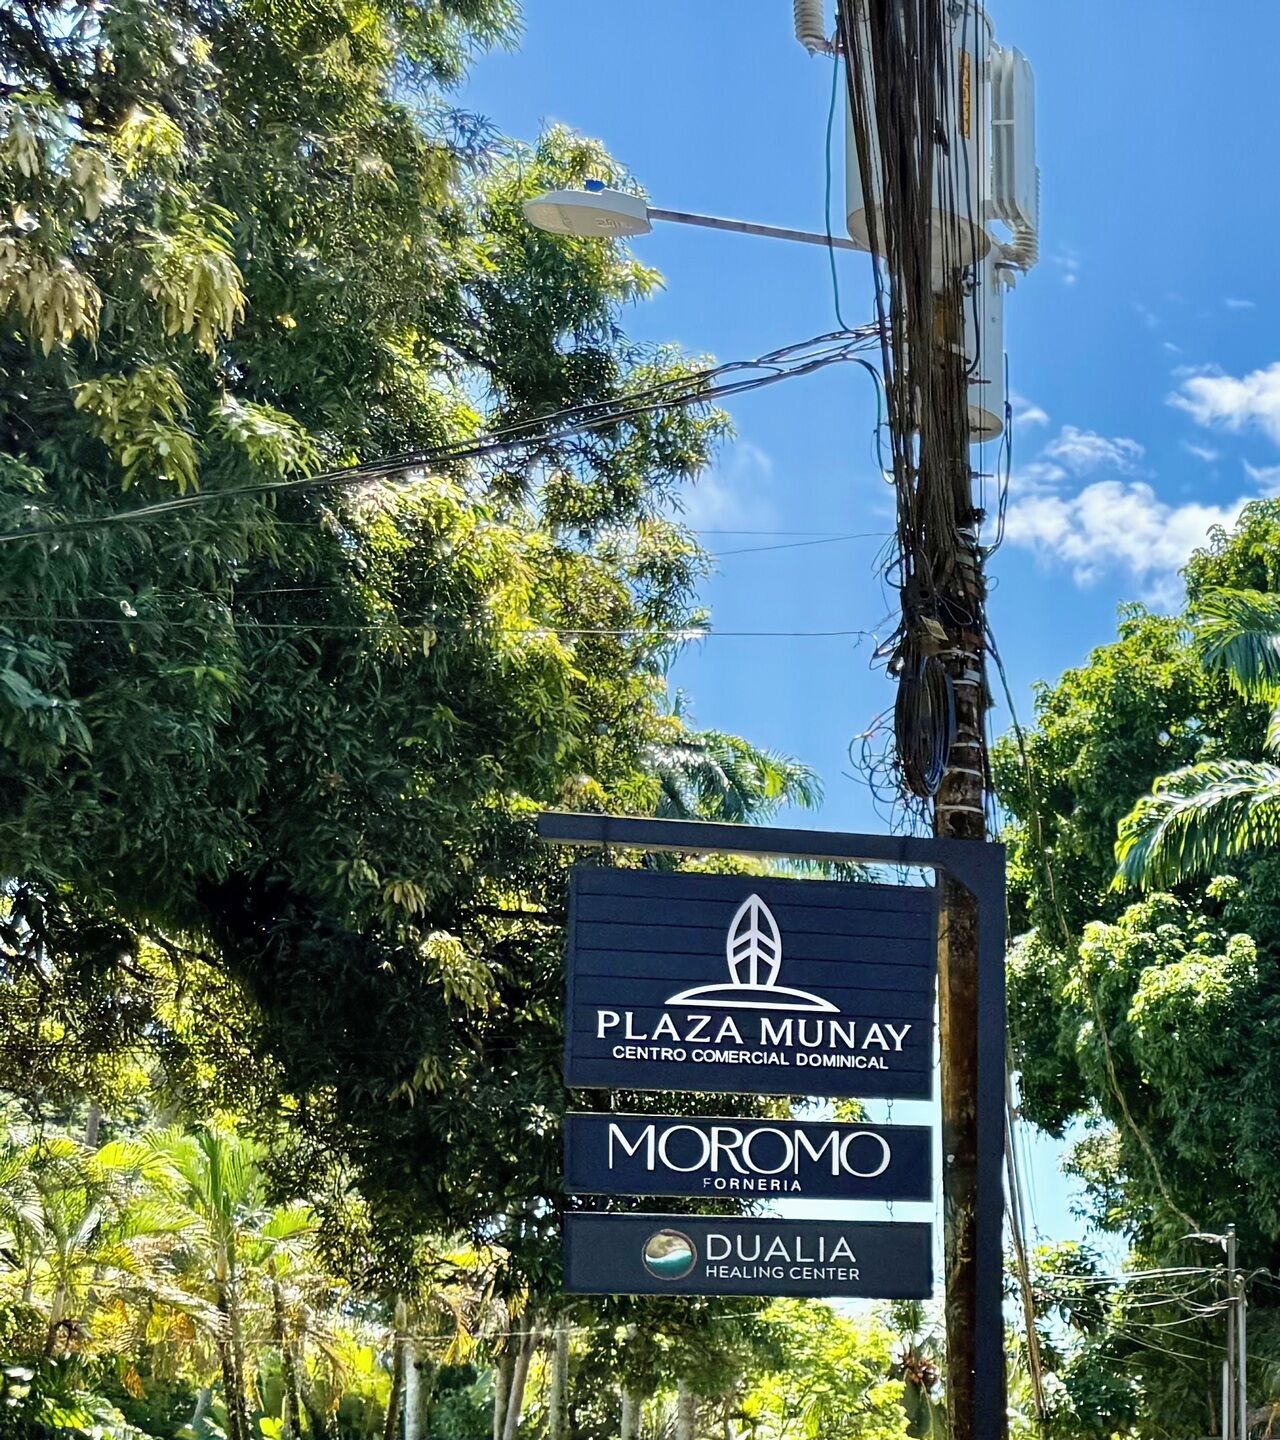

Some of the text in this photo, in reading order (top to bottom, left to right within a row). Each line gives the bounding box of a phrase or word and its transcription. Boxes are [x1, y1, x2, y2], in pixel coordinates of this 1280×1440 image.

[596, 1010, 912, 1051] PLAZA MUNAY
[612, 1045, 889, 1070] CENTRO COMERCIAL DOMINICAL
[608, 1123, 891, 1178] MOROMO
[703, 1177, 801, 1192] FORNERIA
[706, 1234, 857, 1263] DUALIA
[706, 1265, 860, 1281] HEALING CENTER
